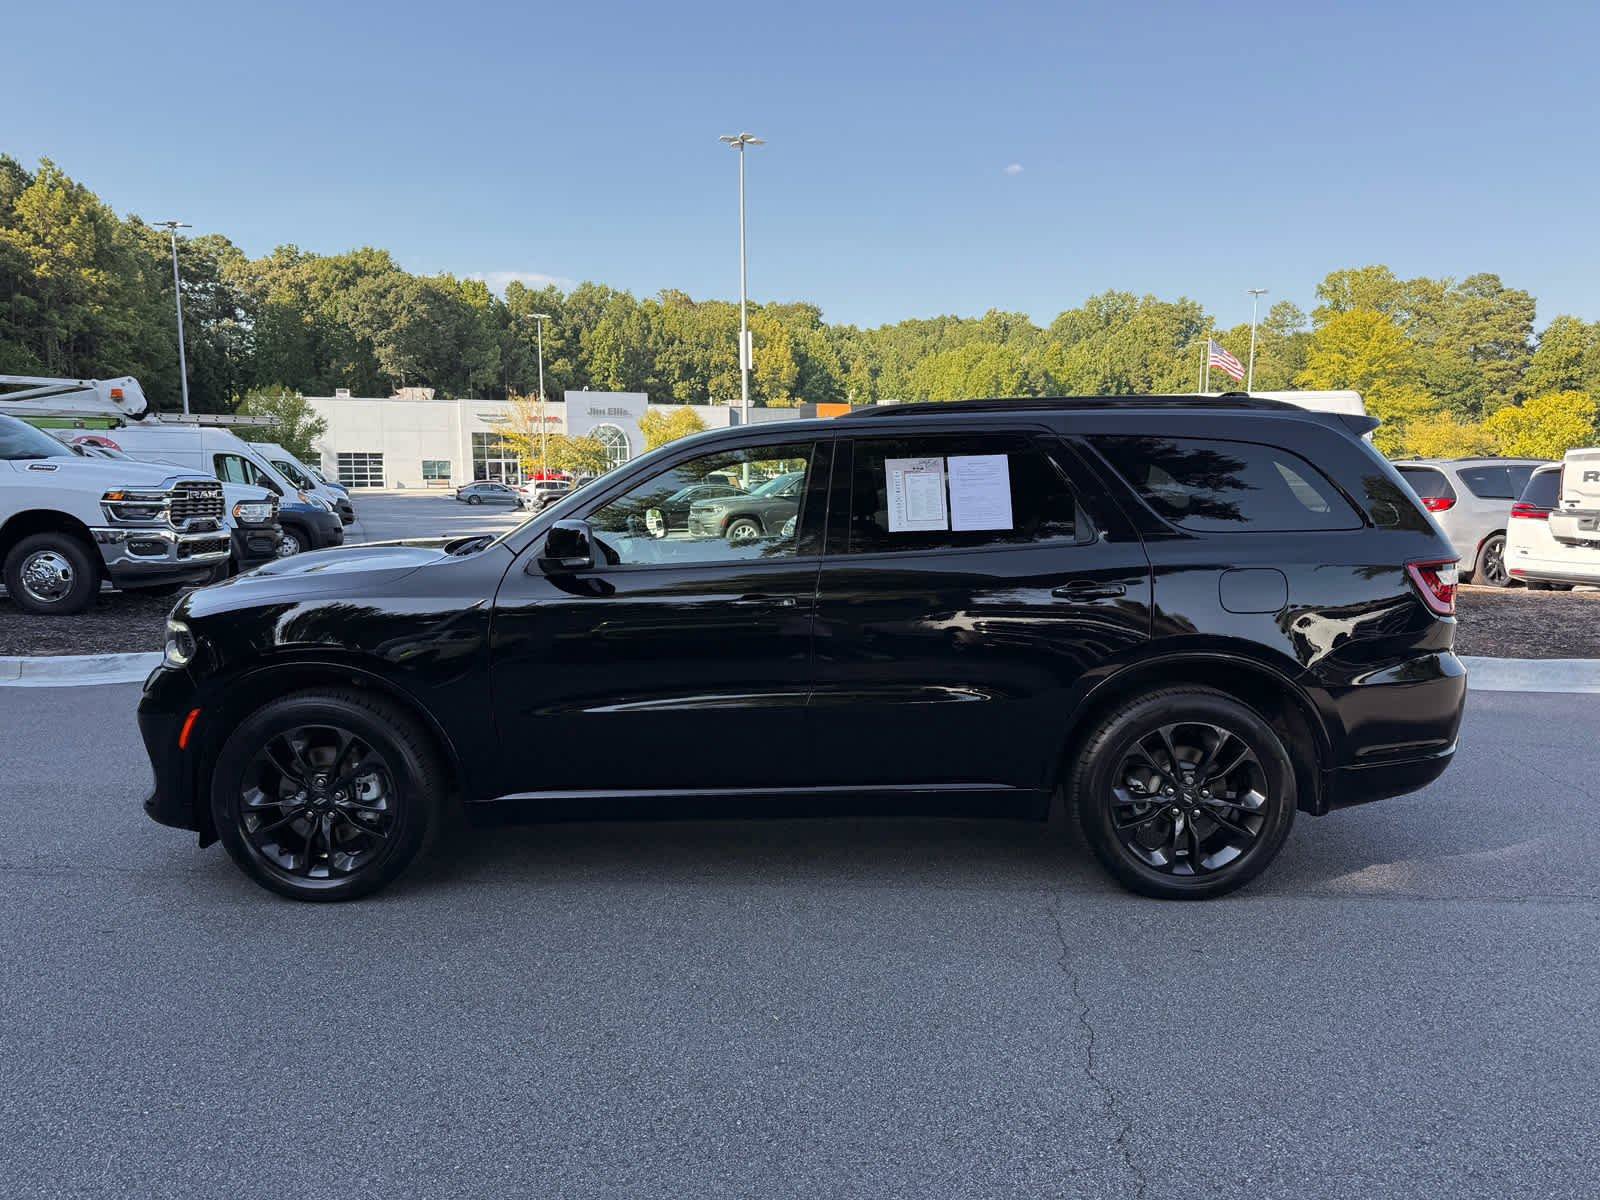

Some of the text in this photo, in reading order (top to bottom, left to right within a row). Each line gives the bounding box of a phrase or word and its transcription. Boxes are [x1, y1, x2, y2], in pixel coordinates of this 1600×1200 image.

[587, 407, 630, 417] Jim Ellis
[189, 489, 217, 499] RAM
